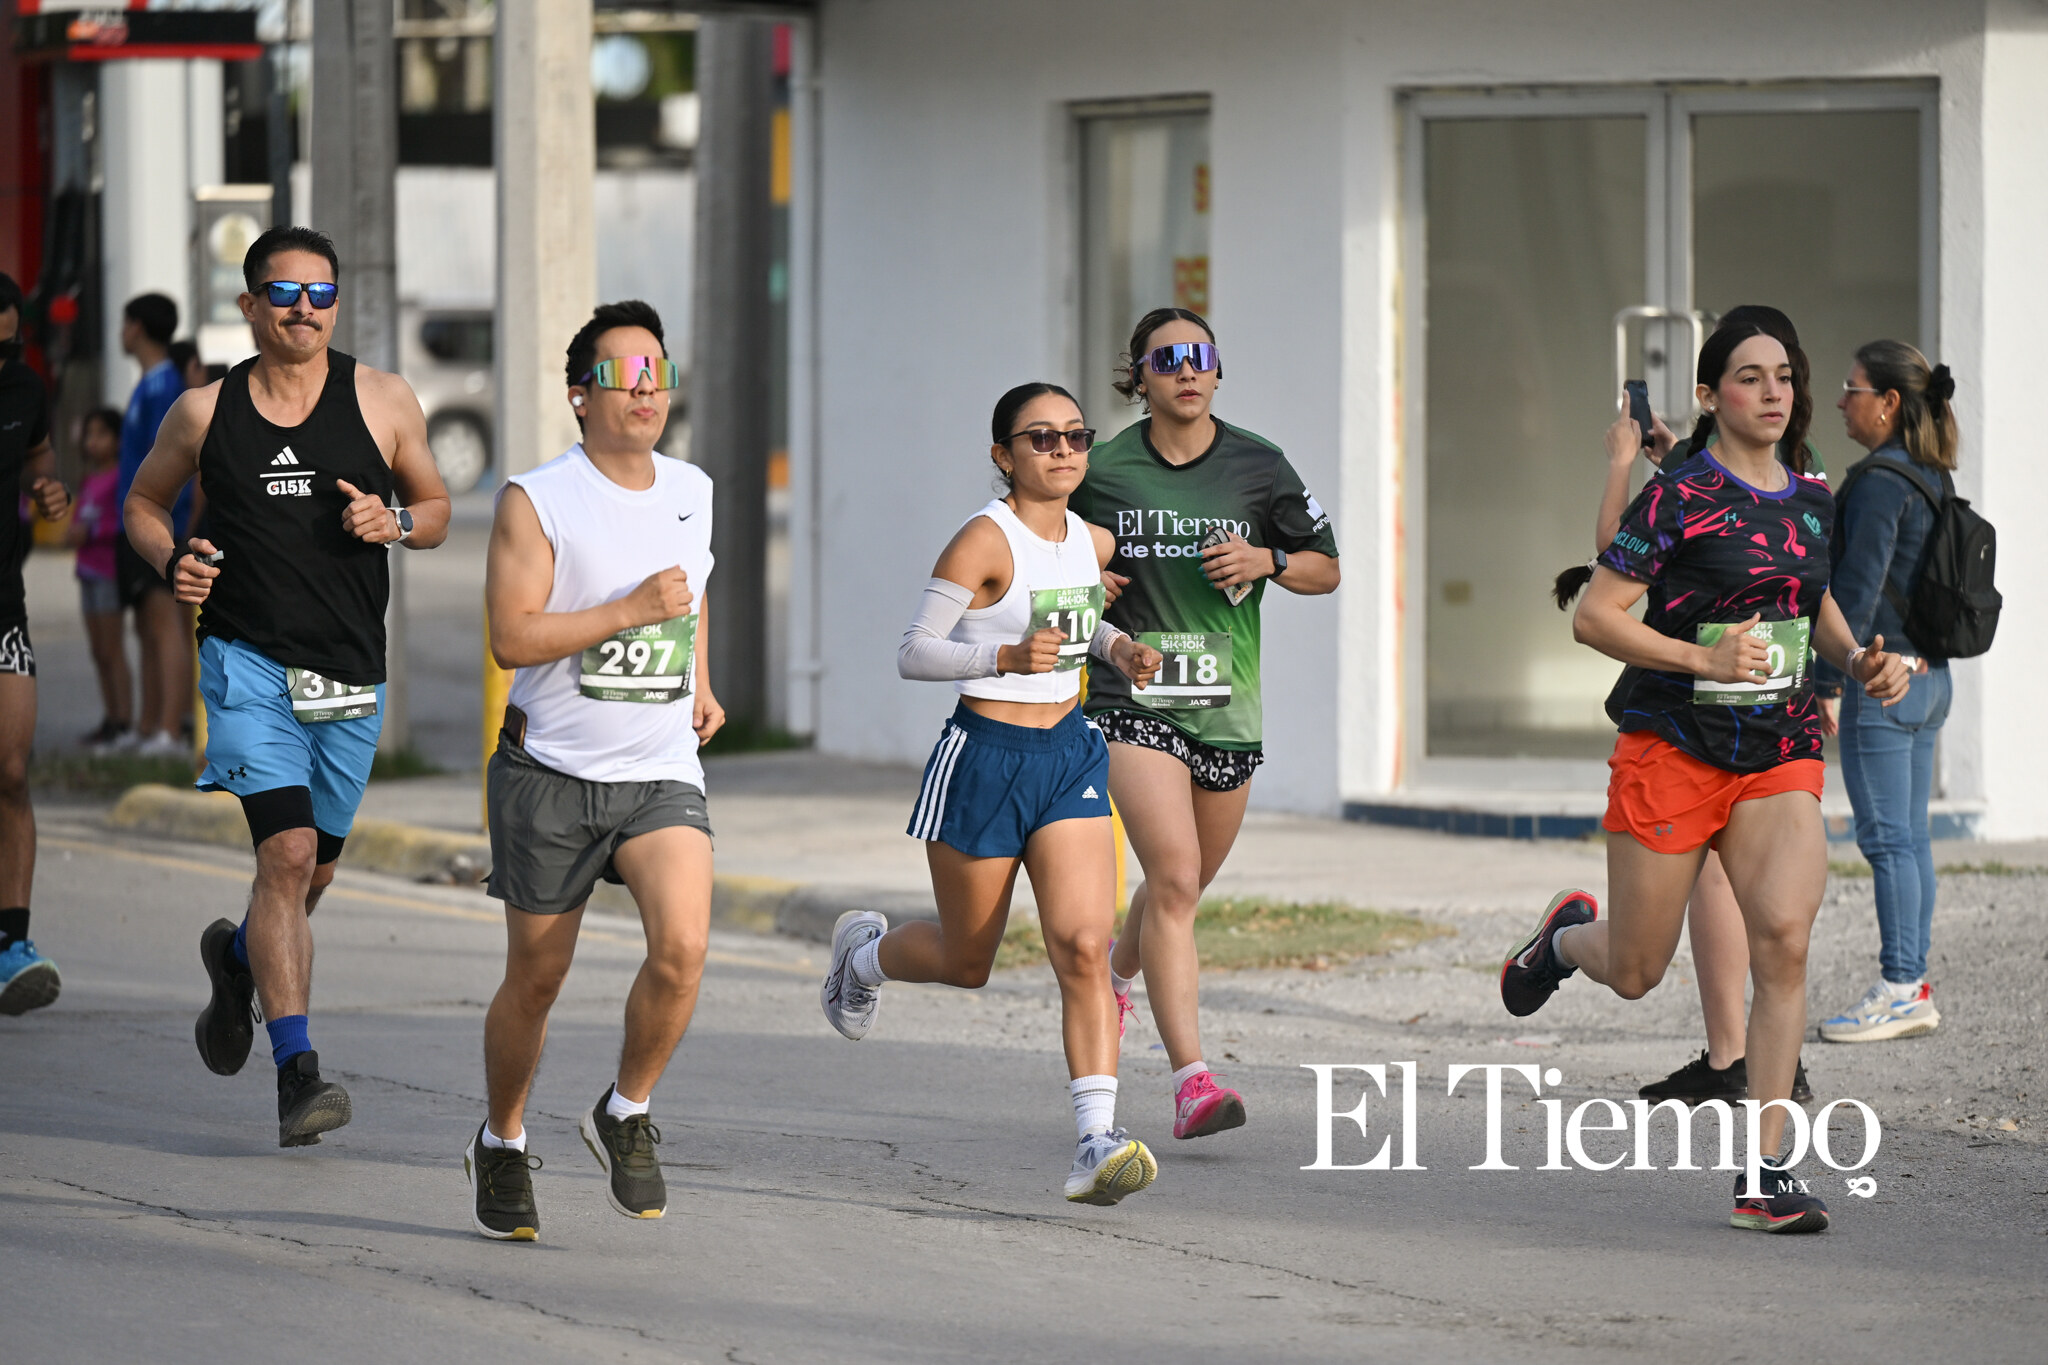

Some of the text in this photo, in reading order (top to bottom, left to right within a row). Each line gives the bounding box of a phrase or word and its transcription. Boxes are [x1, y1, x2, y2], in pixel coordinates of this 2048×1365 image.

[267, 479, 312, 496] G15K
[1116, 509, 1251, 539] El Tiempo
[1119, 541, 1201, 558] de tod
[597, 640, 677, 676] 297
[1794, 634, 1807, 689] MEDALLA
